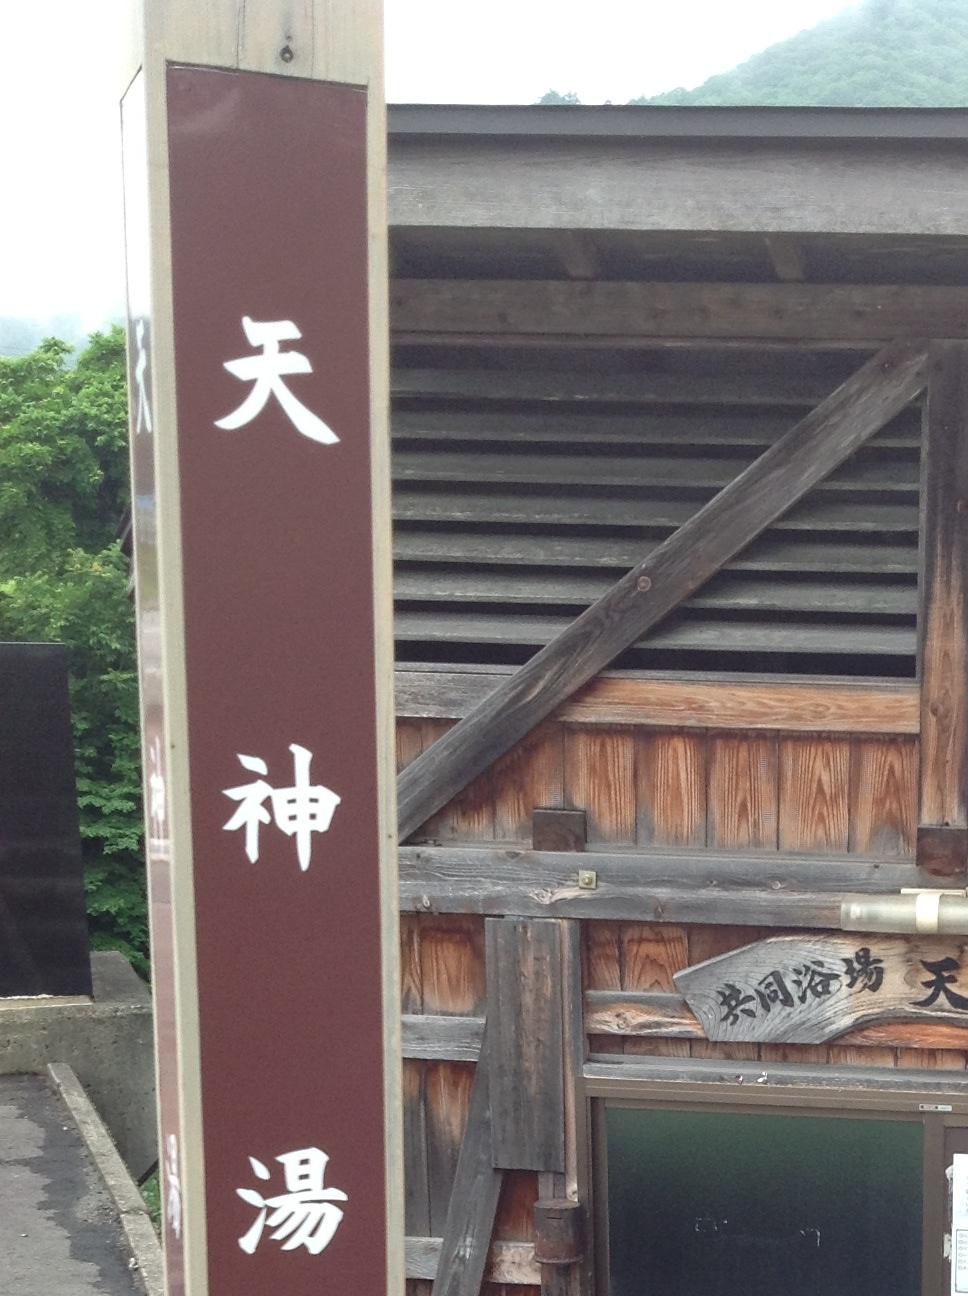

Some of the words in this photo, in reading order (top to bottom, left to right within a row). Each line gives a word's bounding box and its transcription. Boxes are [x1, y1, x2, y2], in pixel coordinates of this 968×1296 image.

[215, 317, 347, 1254] 天神湯
[717, 947, 884, 1025] 共同浴場
